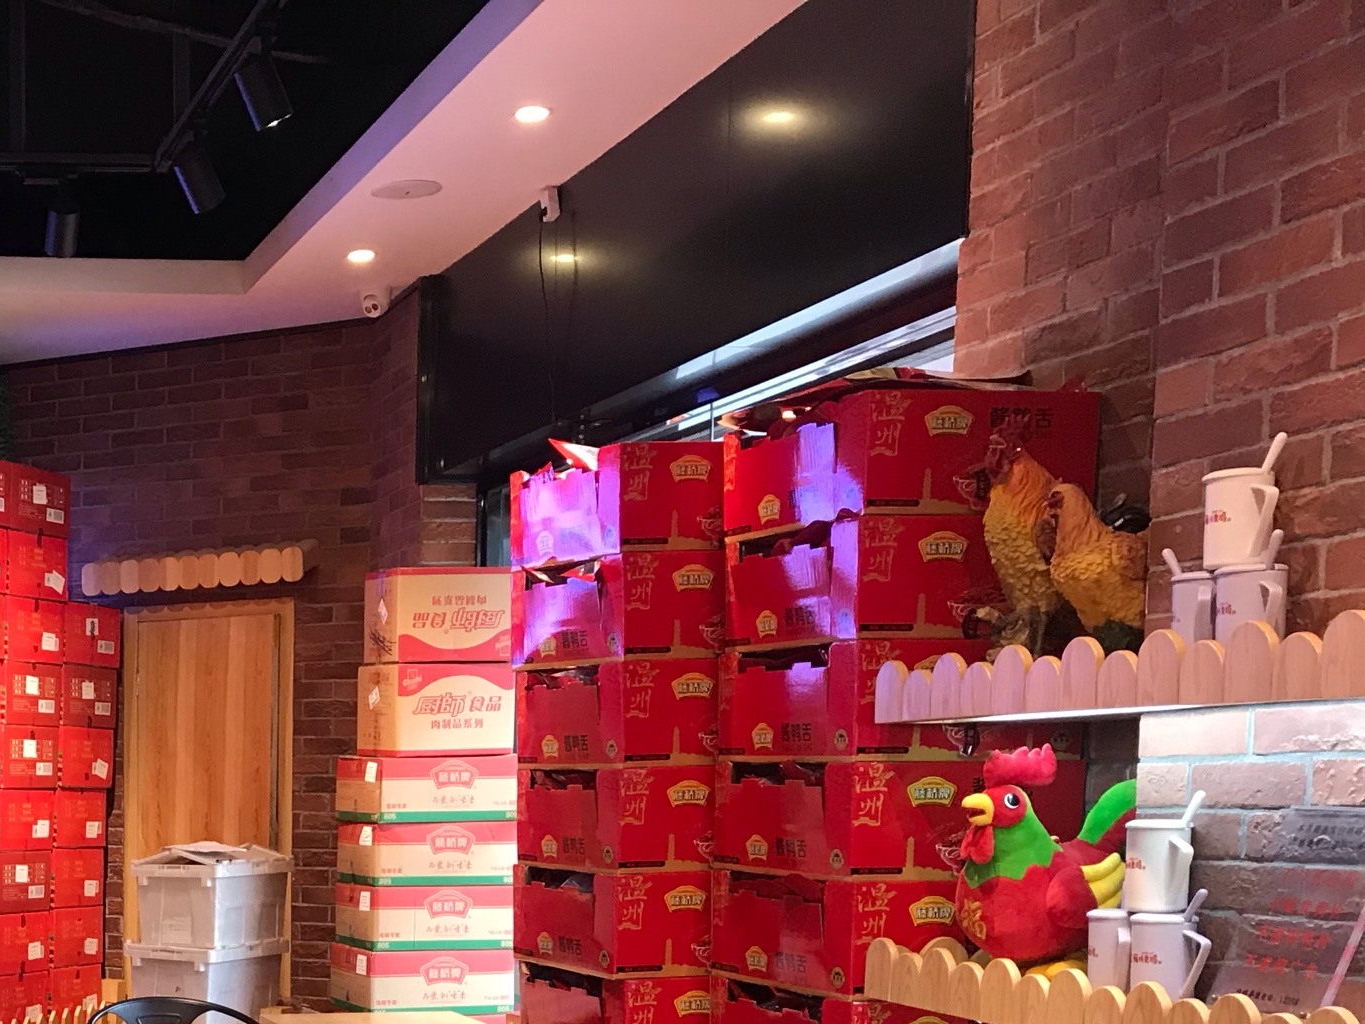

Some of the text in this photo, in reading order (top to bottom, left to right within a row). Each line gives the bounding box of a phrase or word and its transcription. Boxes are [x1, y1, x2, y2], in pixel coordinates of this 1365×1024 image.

[469, 695, 502, 712] 食品
[431, 718, 483, 729] 肉制品系列
